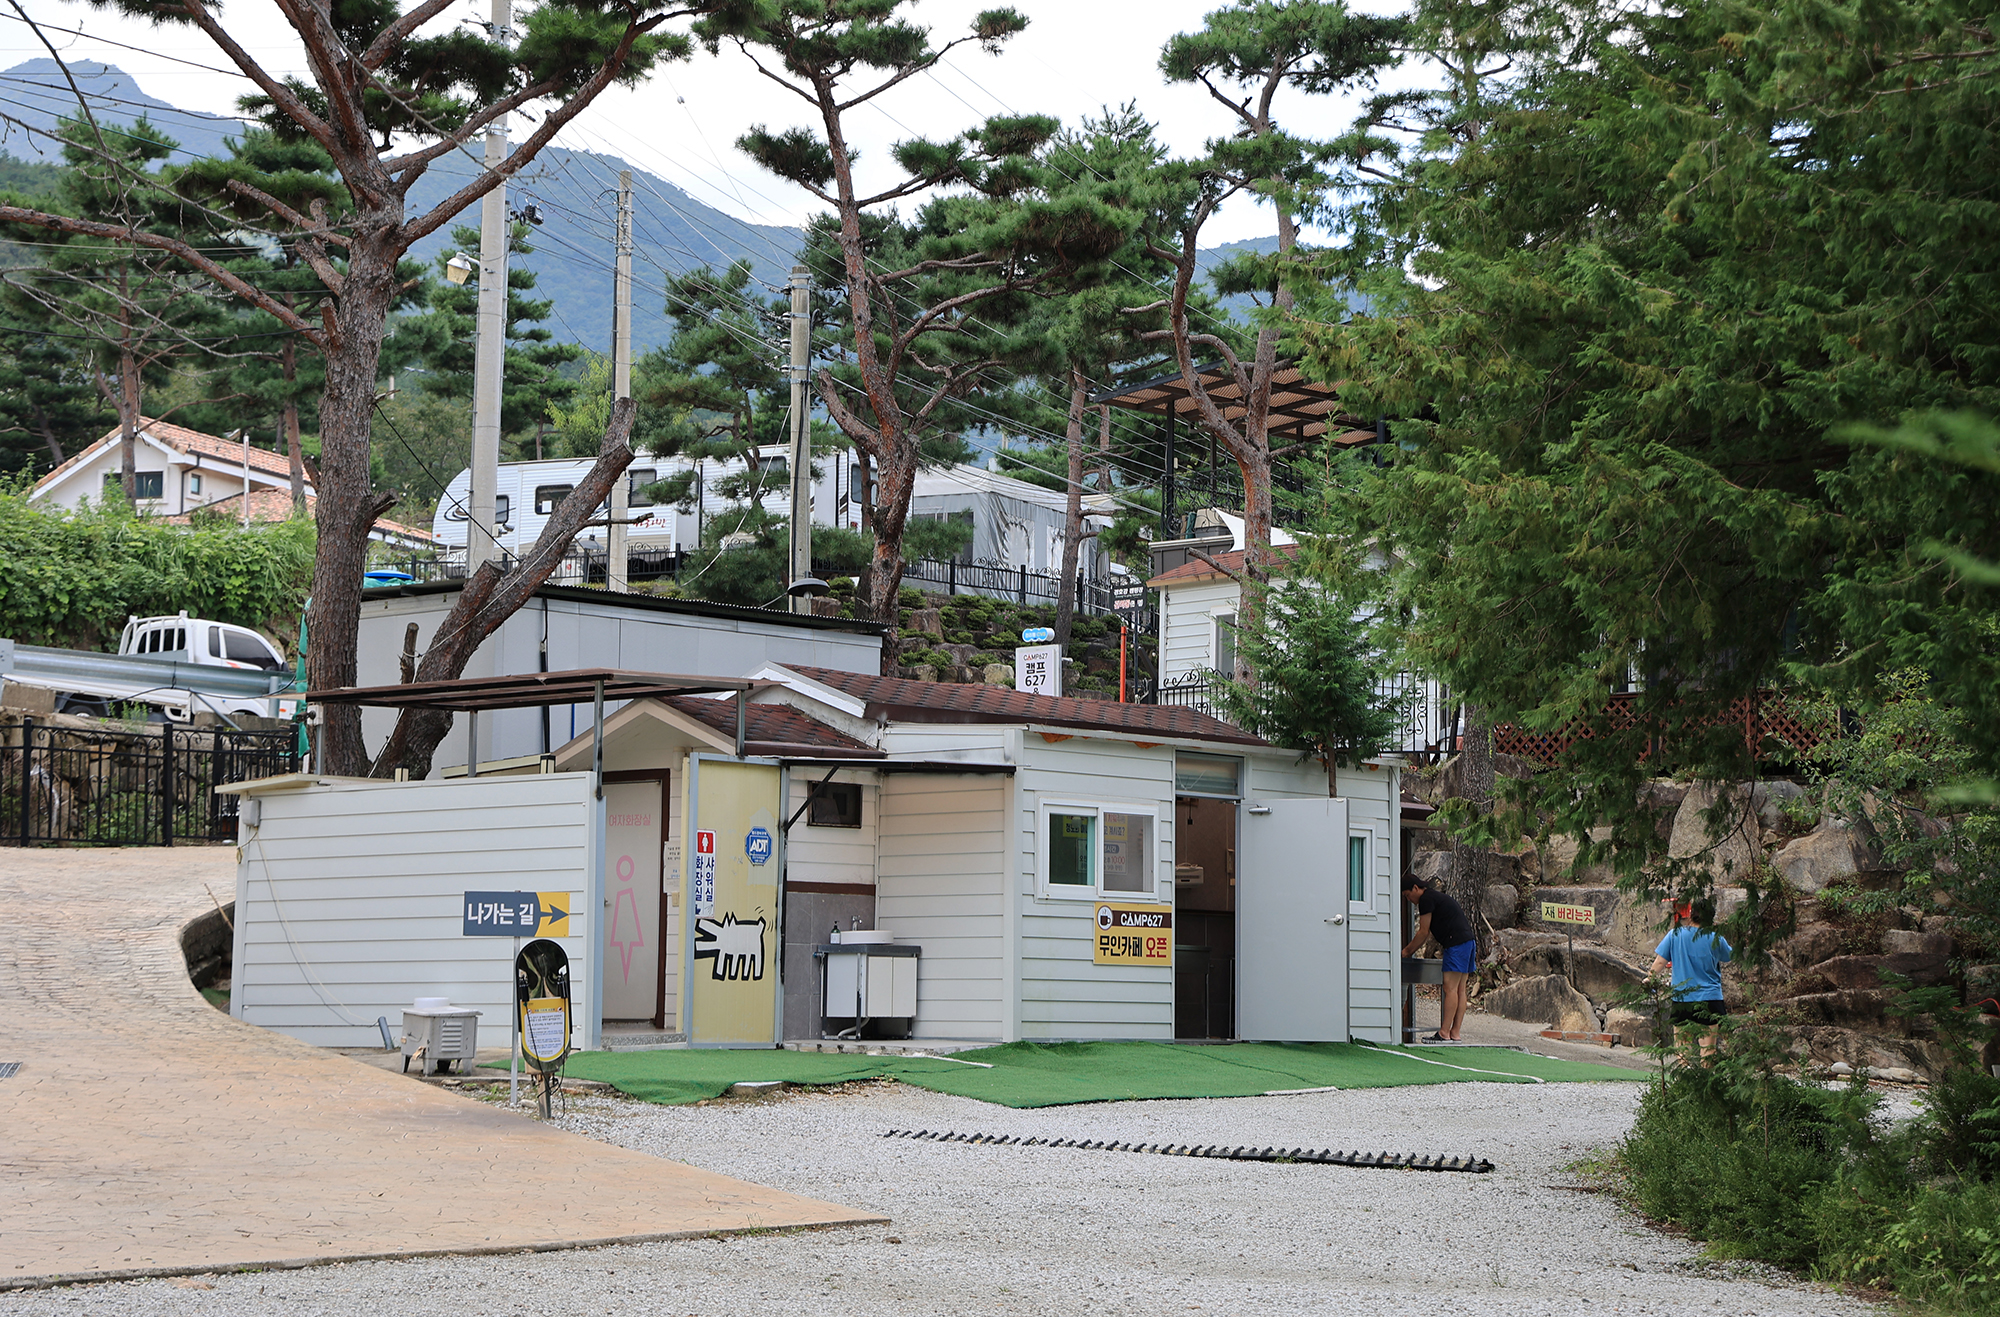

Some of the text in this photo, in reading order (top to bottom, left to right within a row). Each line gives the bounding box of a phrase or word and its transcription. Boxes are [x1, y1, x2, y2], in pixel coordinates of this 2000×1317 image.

[1023, 652, 1048, 661] CAMP627
[1026, 662, 1046, 674] 캠프
[1025, 674, 1046, 687] 627
[608, 814, 651, 827] 여자화장실
[750, 839, 768, 853] ADT
[706, 857, 714, 902] 샤워실
[467, 903, 534, 925] 나가는 길
[1120, 912, 1163, 927] CAMP627
[1558, 907, 1592, 922] 버리는곳
[1100, 936, 1167, 958] 무인카페 오픈
